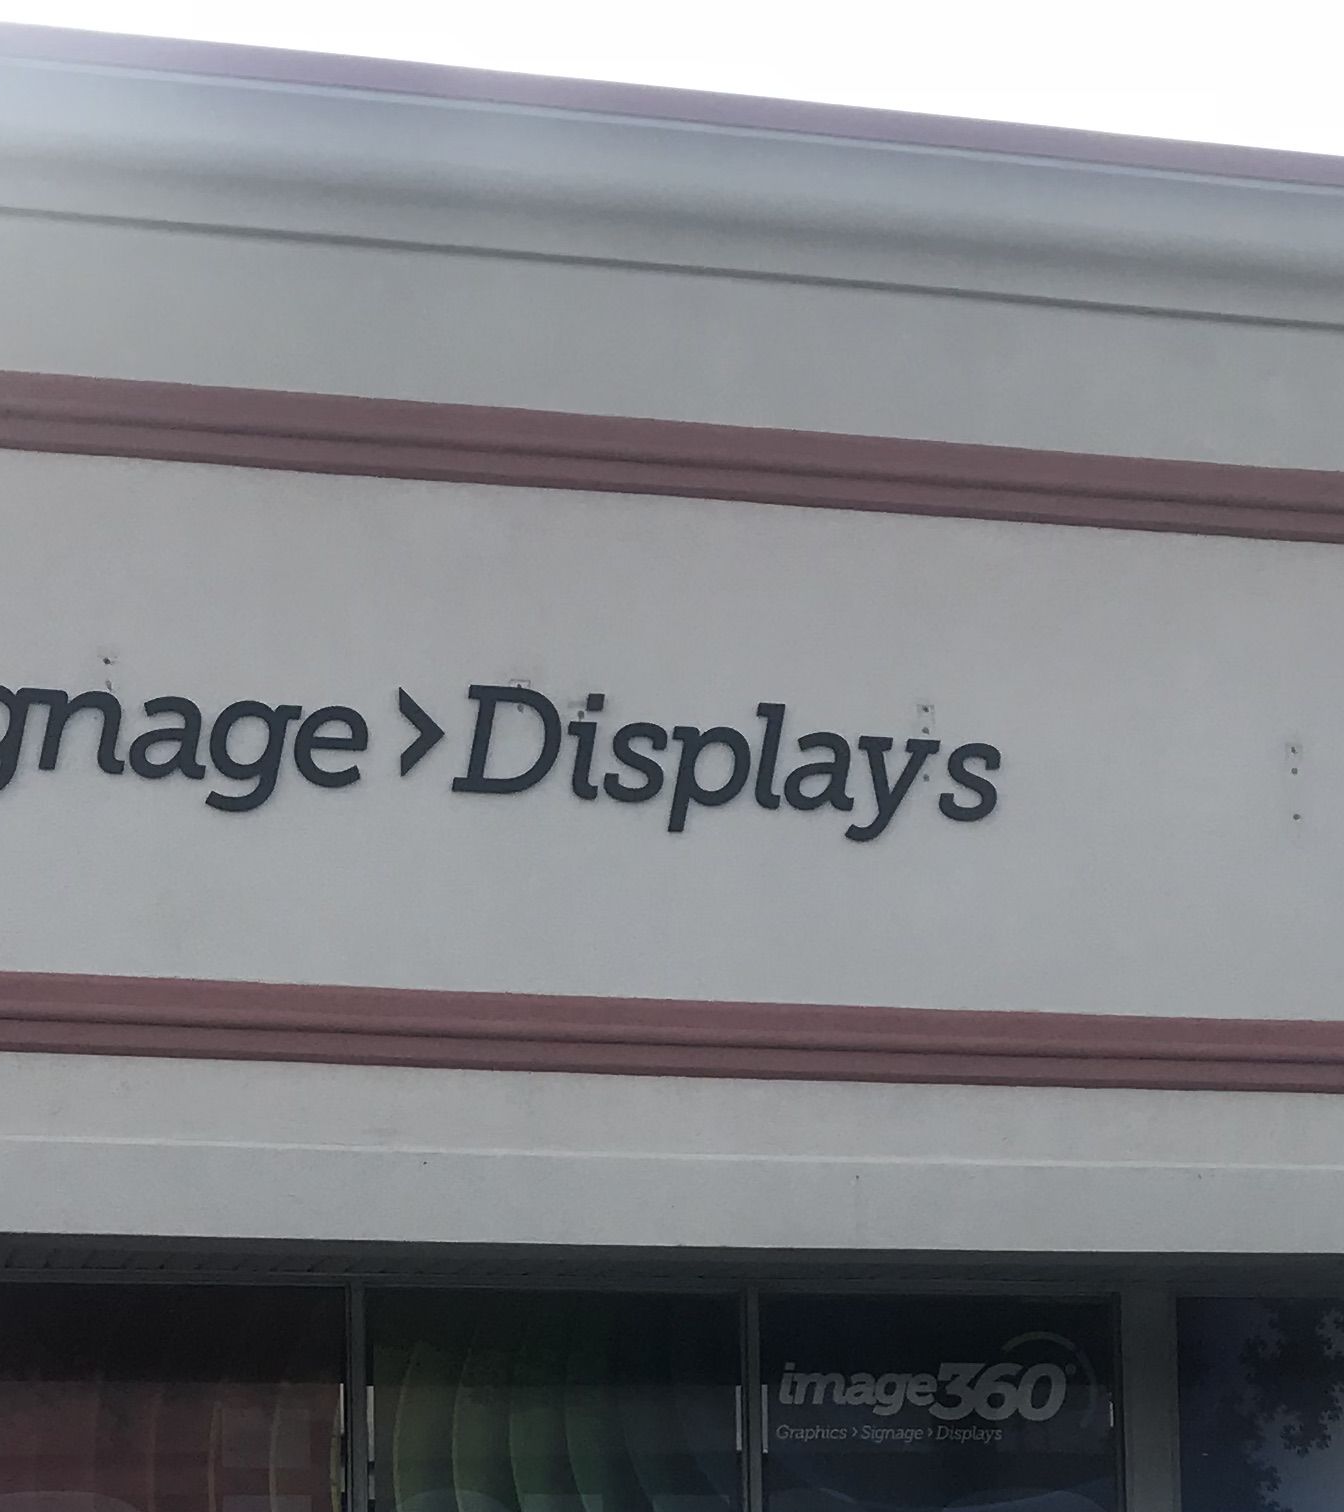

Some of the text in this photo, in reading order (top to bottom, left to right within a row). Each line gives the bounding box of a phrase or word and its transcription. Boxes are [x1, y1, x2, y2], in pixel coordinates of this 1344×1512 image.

[453, 683, 1001, 841] Displays
[776, 1424, 1003, 1444] Graphics Signage Displays
